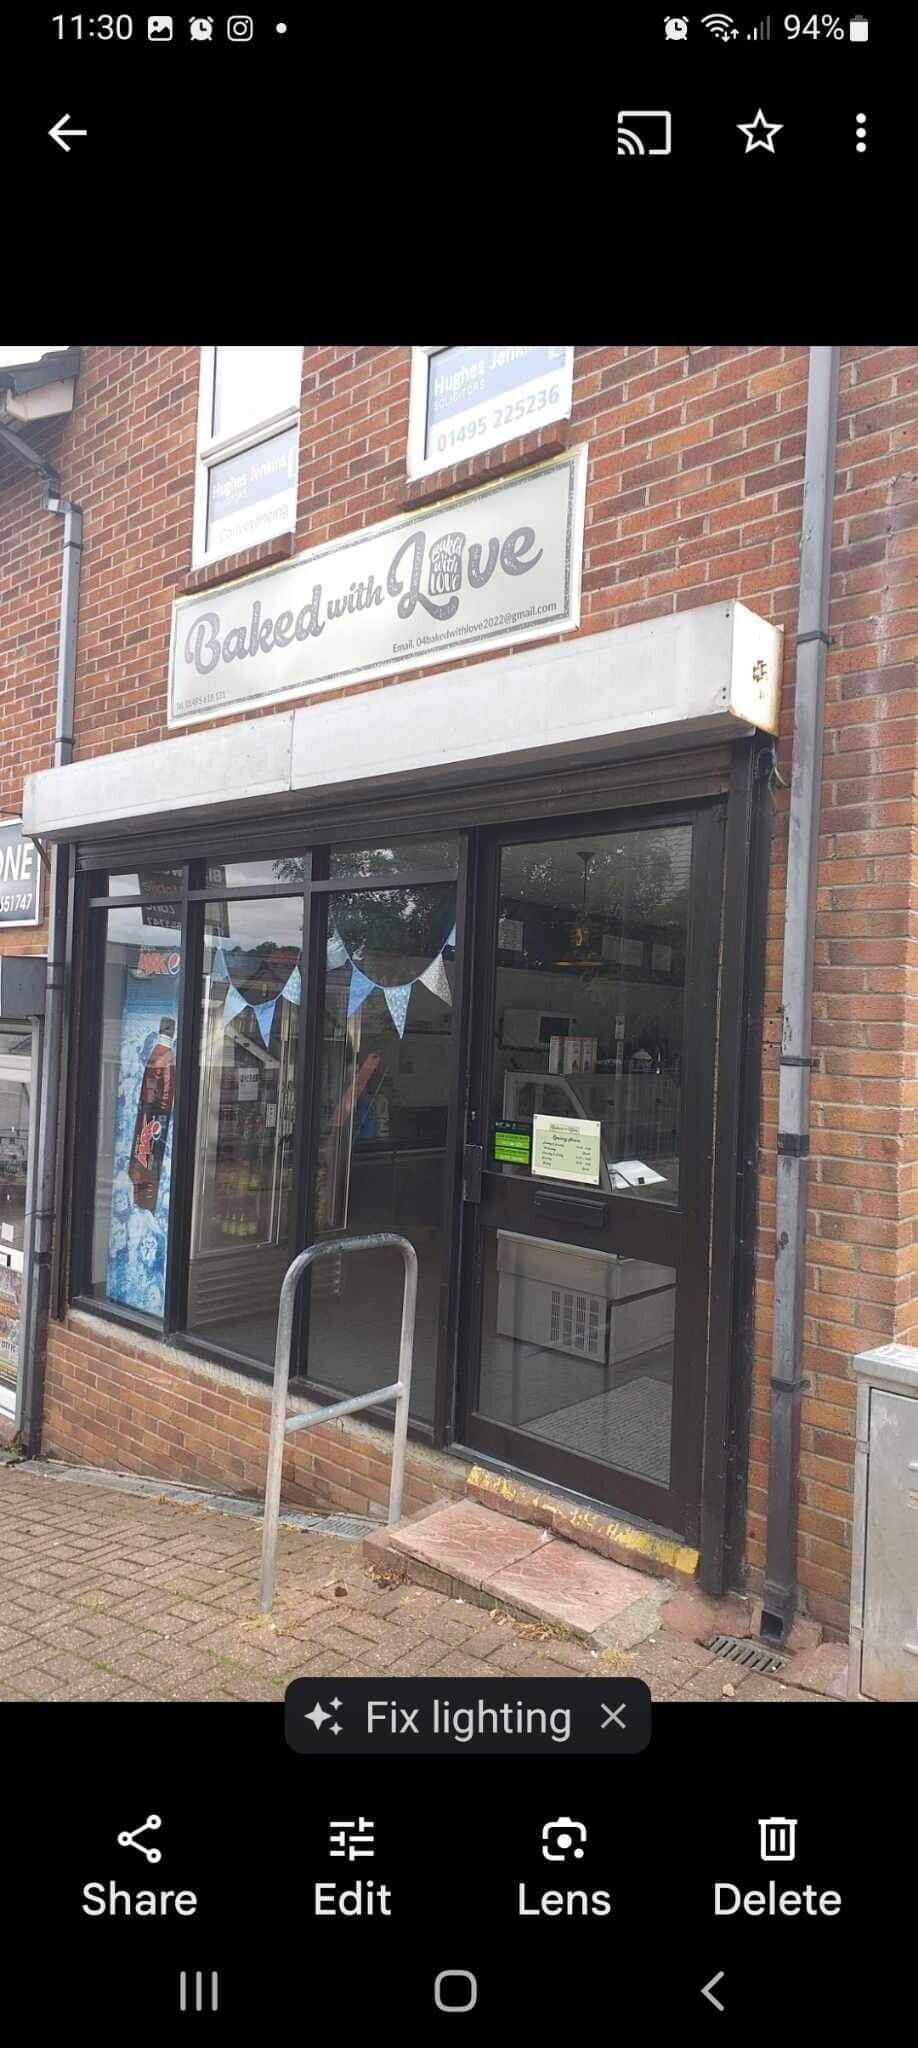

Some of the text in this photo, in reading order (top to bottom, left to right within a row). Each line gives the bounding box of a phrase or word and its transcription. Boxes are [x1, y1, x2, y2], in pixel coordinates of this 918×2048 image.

[434, 360, 486, 397] Hughes
[437, 384, 560, 452] 01495 225236
[184, 584, 326, 675] Baked
[327, 575, 385, 620] with
